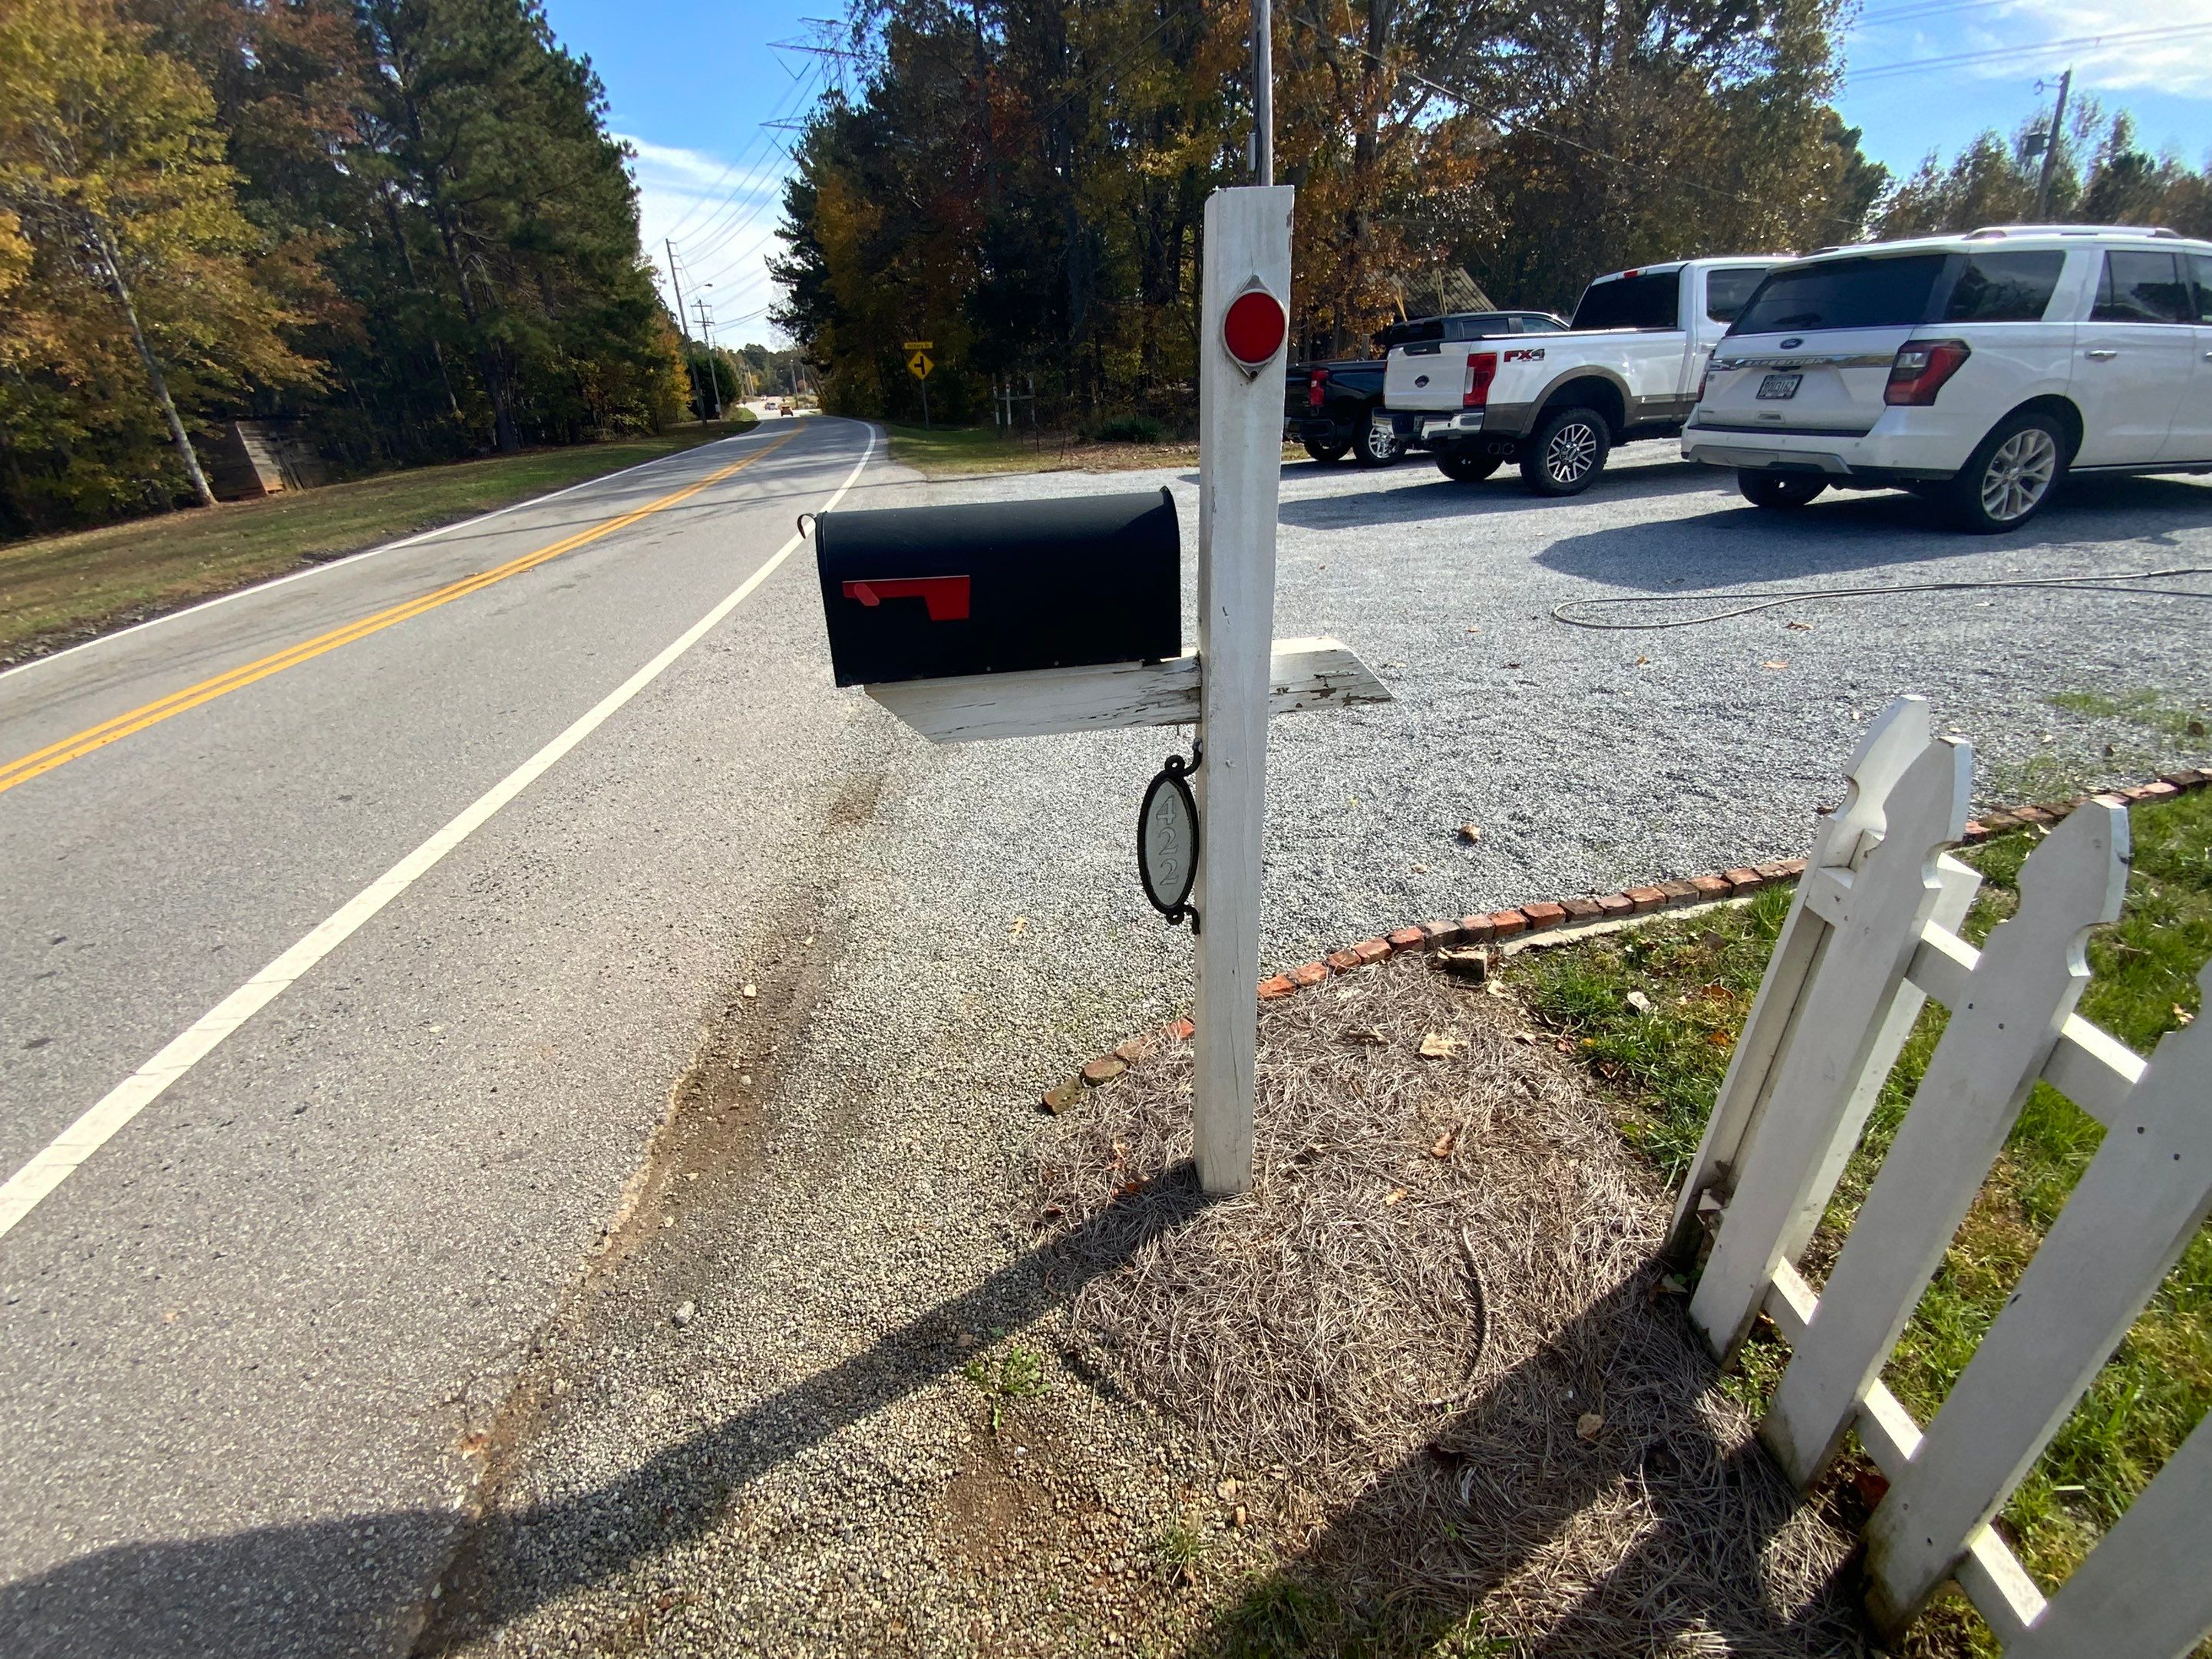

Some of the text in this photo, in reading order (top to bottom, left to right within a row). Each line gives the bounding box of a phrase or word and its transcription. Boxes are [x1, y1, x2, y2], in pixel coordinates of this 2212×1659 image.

[1503, 348, 1545, 363] FX4
[1744, 358, 1827, 367] EXPEDITION
[1155, 794, 1179, 886] 422
